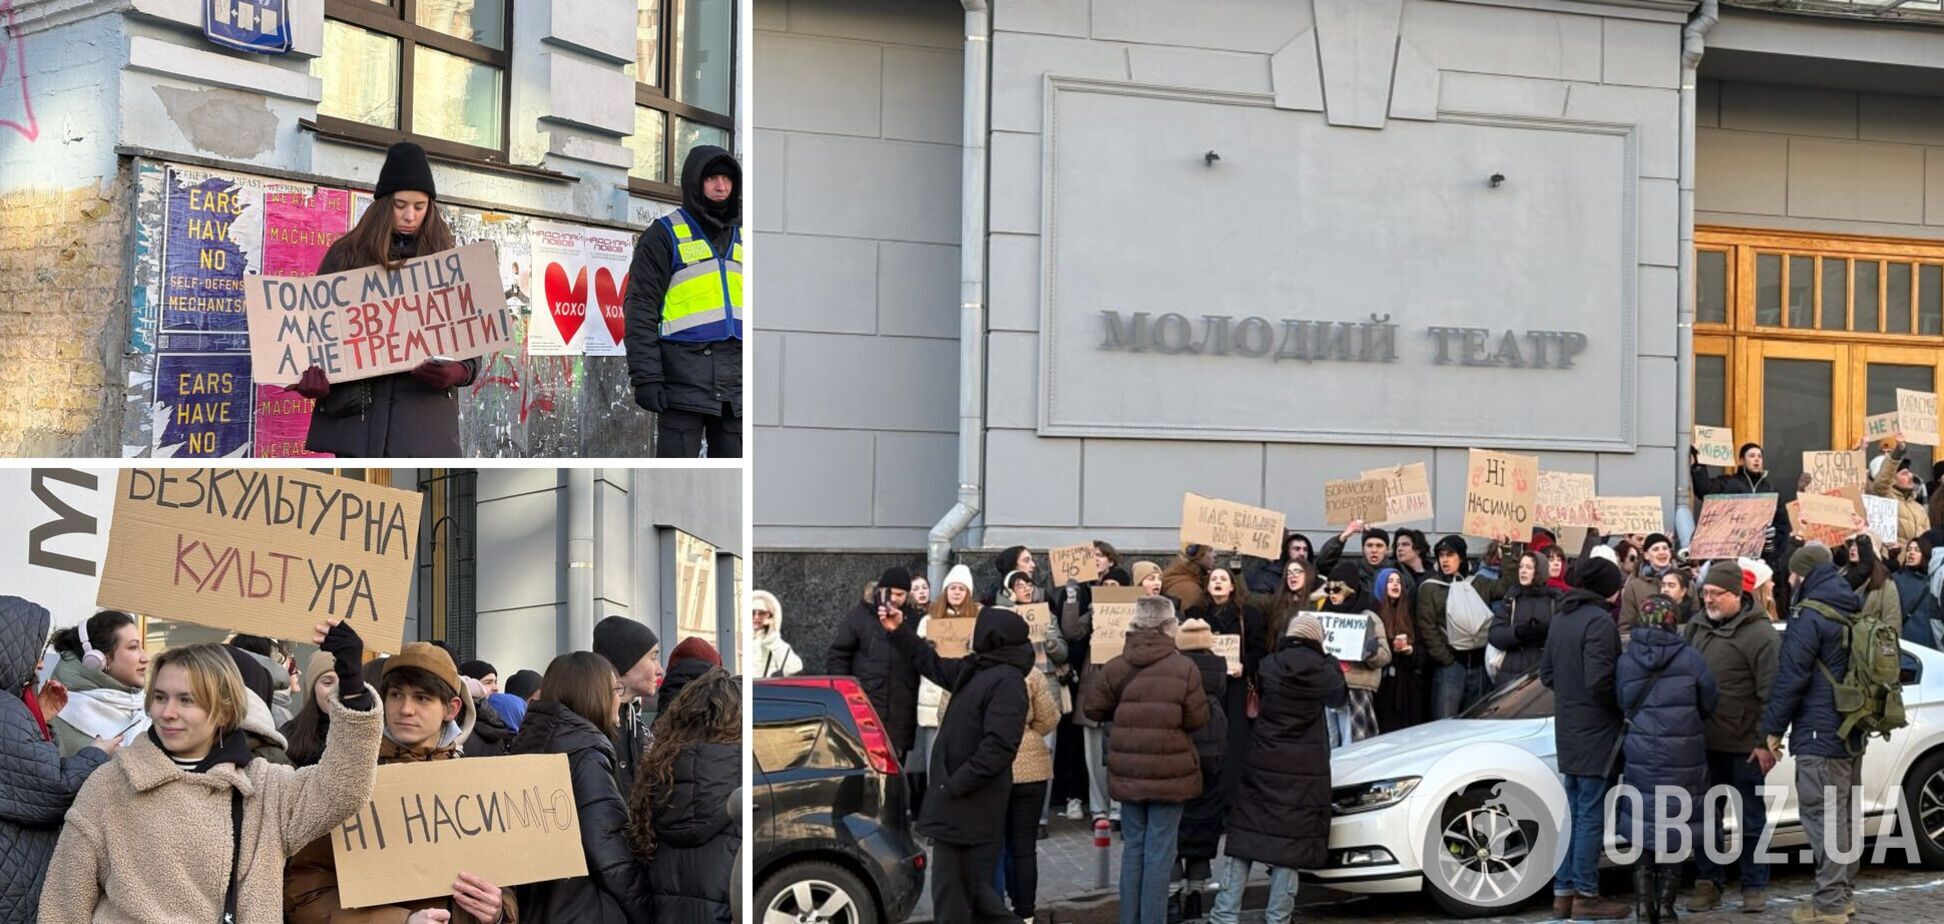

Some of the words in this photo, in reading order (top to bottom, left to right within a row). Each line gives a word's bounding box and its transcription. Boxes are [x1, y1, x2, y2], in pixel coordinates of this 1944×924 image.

[190, 189, 242, 215] EARS
[188, 219, 238, 244] HAV
[200, 248, 225, 270] NO
[170, 276, 244, 291] SELF-DEFENS
[263, 276, 351, 311] ГОЛОС
[361, 254, 466, 303] МИТЦЯ
[277, 311, 341, 344] МАЄ
[346, 283, 484, 339] ЗВУЧАТИ,
[605, 305, 624, 318] XOX
[1099, 310, 1400, 365] МОЛОДИЙ
[1427, 326, 1588, 369] ТЕАТР
[278, 344, 299, 375] А
[307, 343, 342, 374] НЕ
[179, 373, 233, 395] EARS
[177, 402, 231, 424] HAVE
[262, 399, 316, 416] MACHIN
[189, 432, 216, 454] NO
[1814, 452, 1852, 468] СТОП
[129, 468, 409, 561] БЕЗКУЛЬТУРНА
[1198, 506, 1228, 525] НАС
[1252, 532, 1271, 549] 46
[1317, 615, 1366, 631] ТРИМУЮ
[342, 800, 386, 852] НІ
